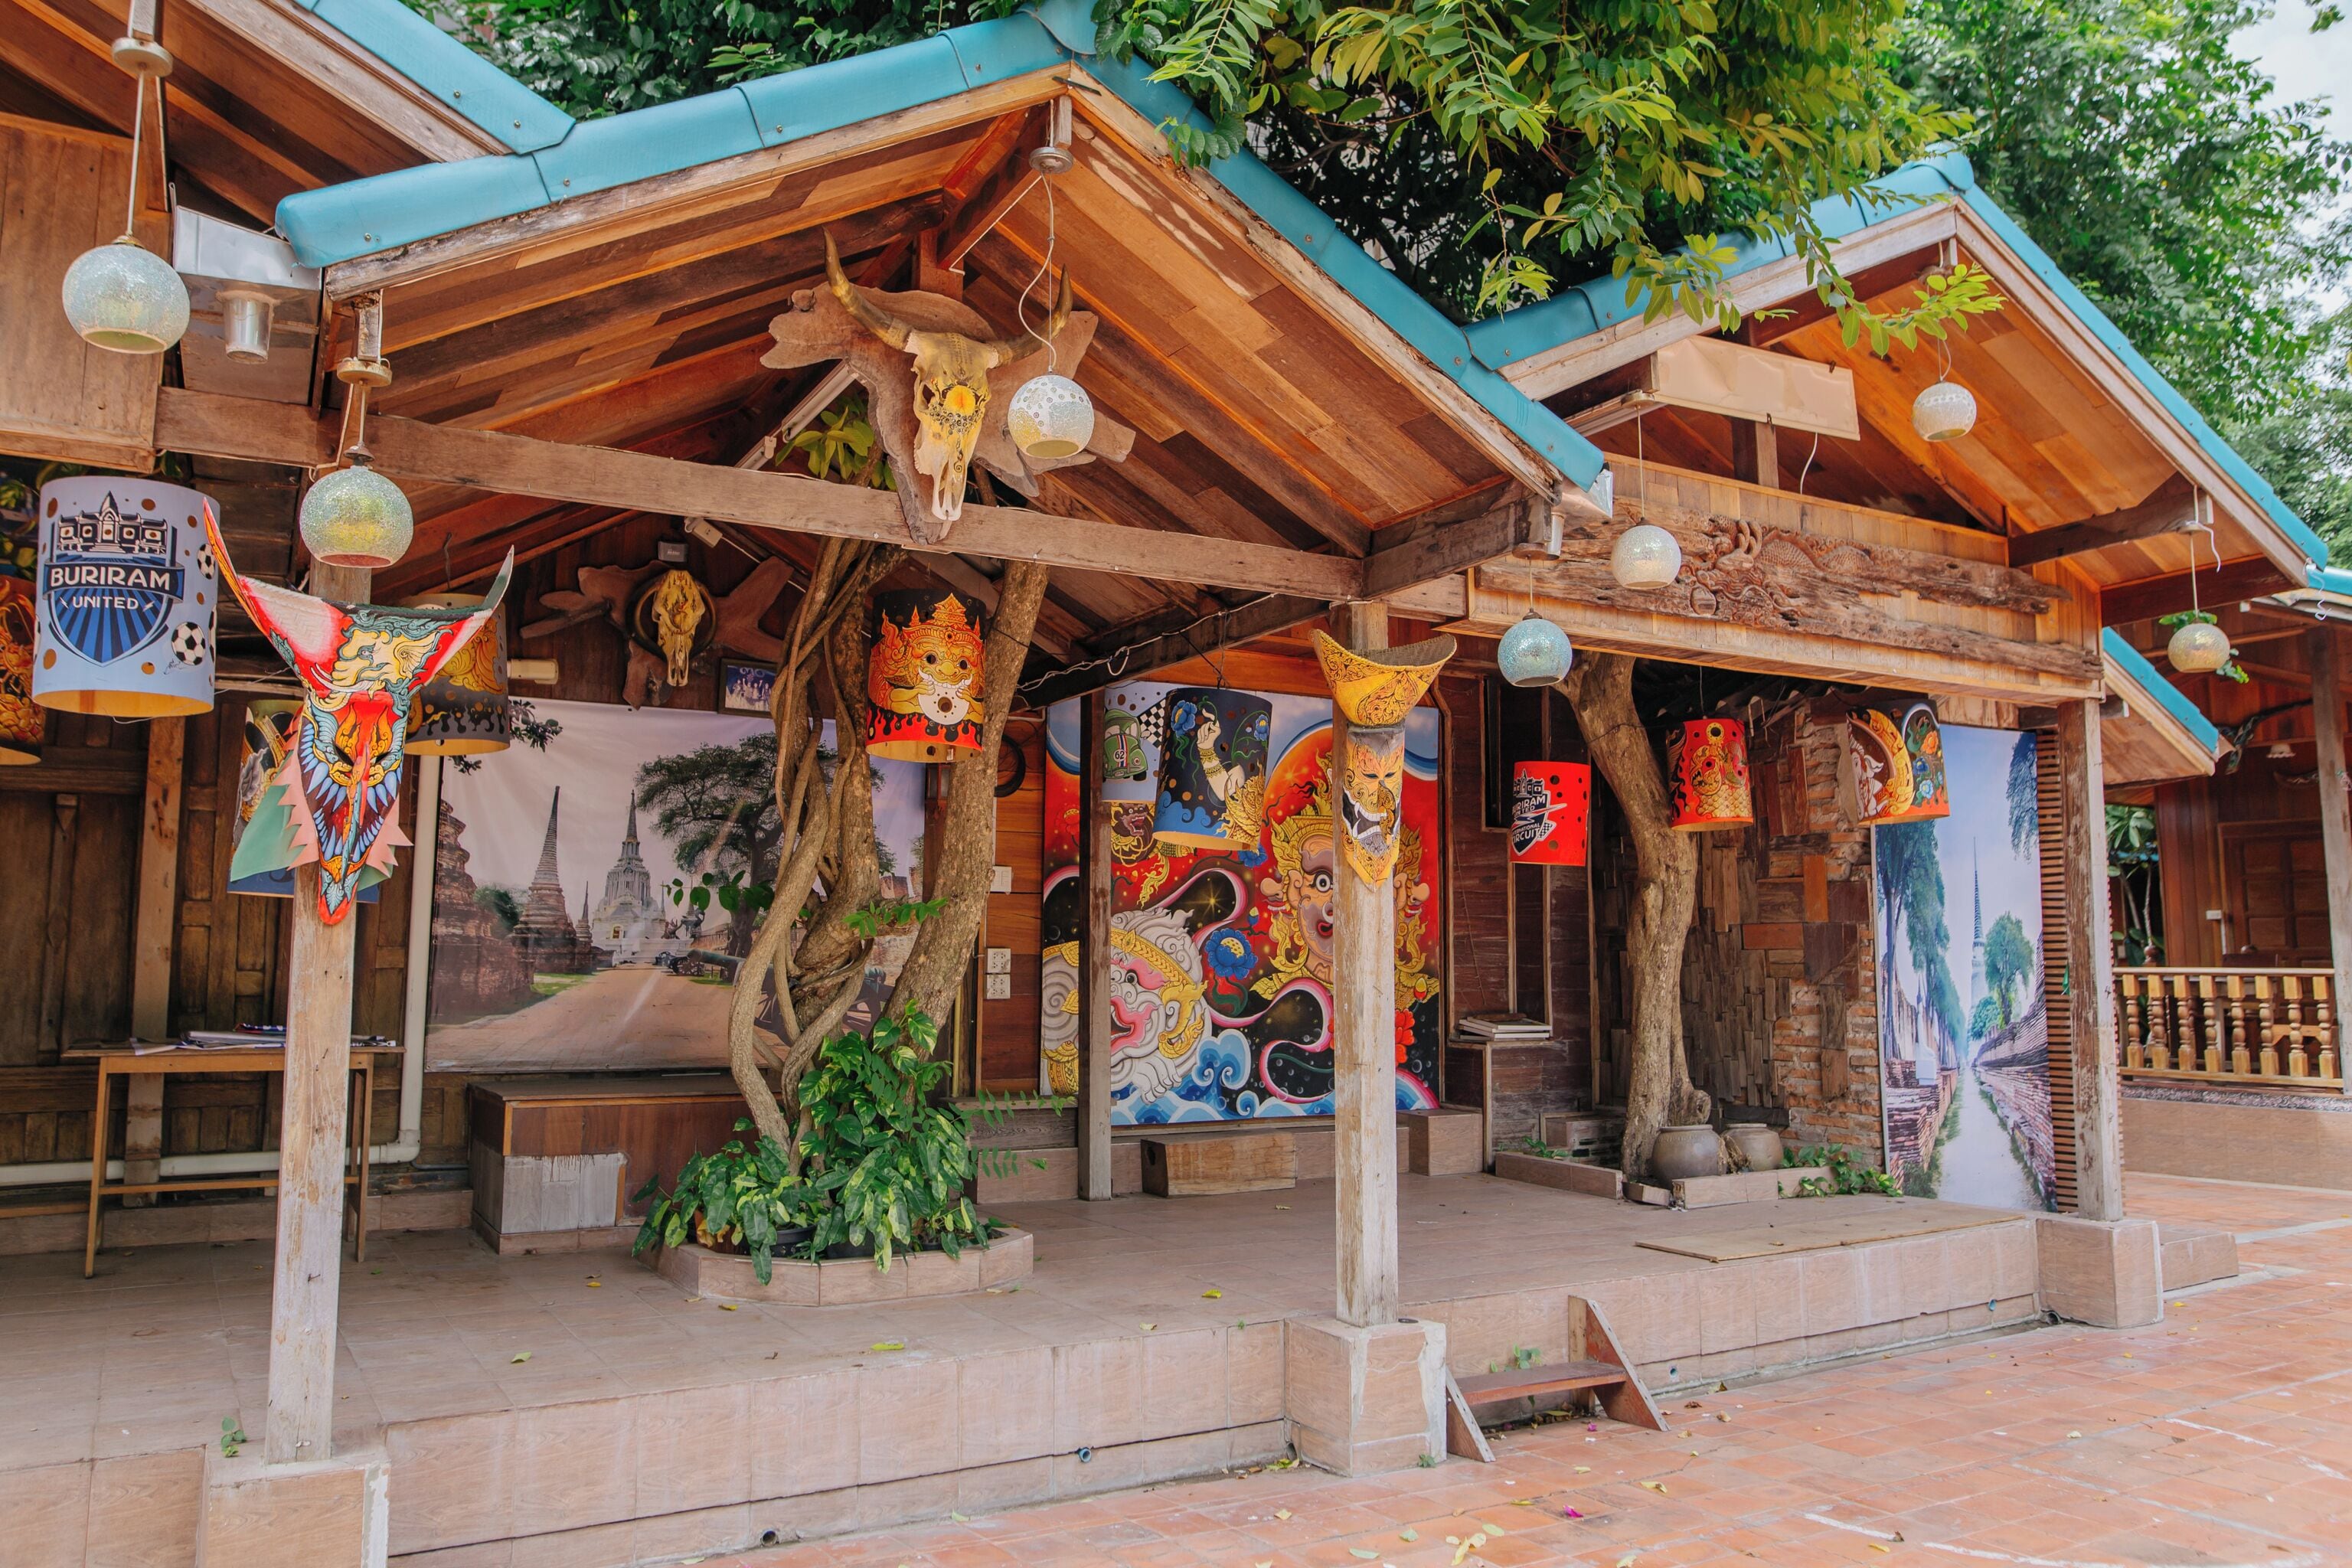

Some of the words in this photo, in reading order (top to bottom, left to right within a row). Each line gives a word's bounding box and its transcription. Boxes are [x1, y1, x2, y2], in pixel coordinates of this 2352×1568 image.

[50, 565, 170, 592] BURIRAM
[72, 596, 139, 610] UNITED
[1115, 750, 1125, 760] 62
